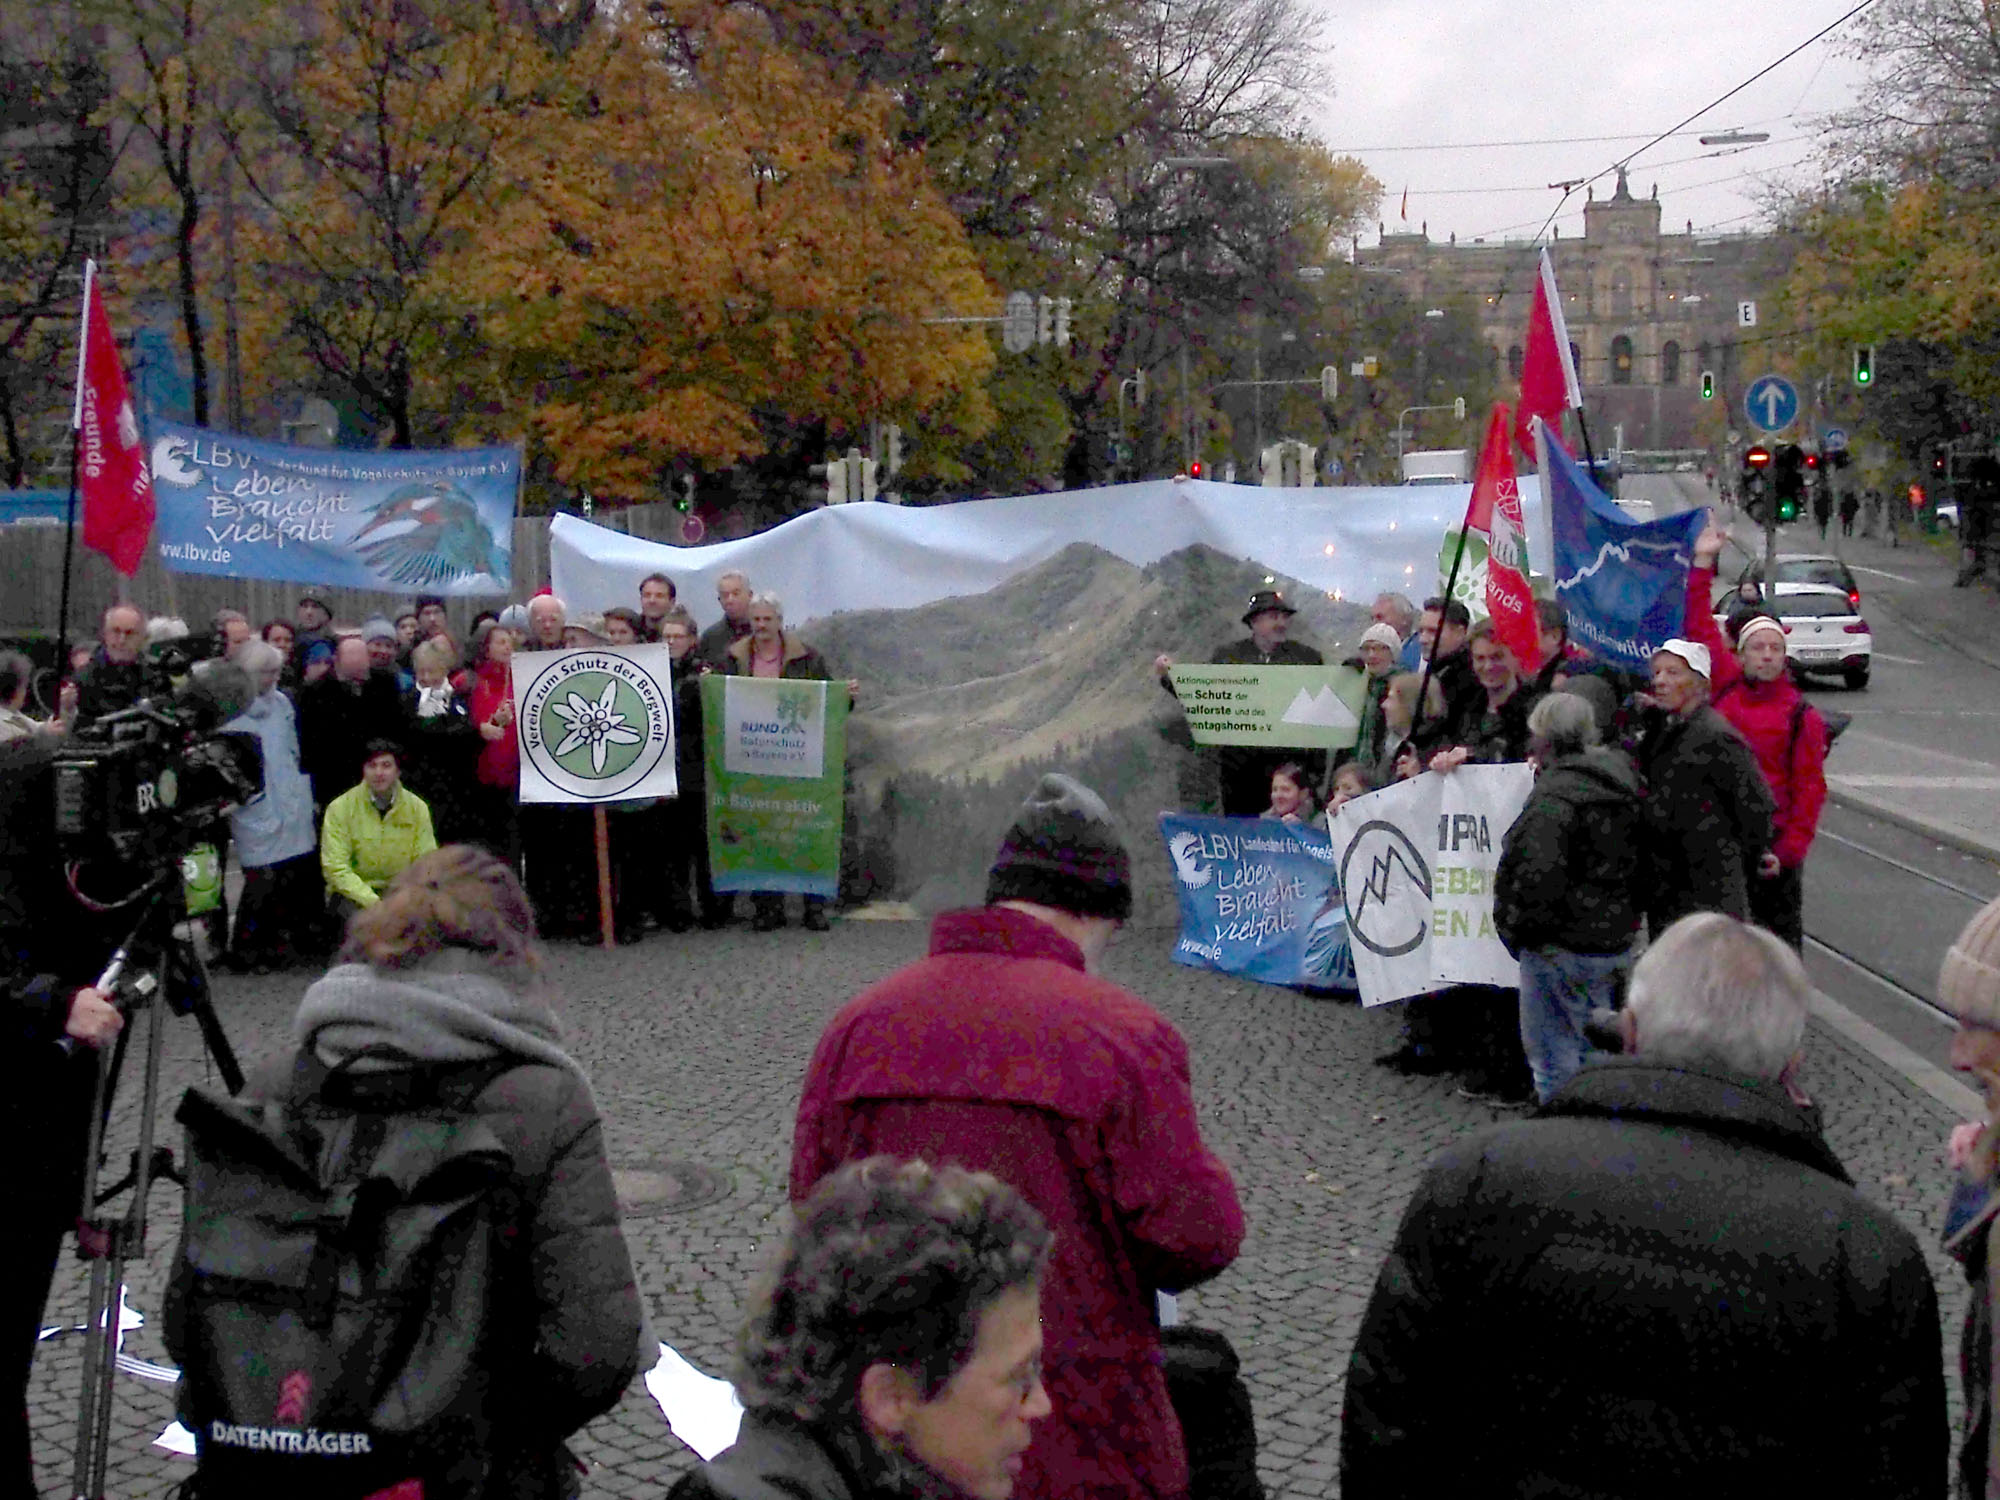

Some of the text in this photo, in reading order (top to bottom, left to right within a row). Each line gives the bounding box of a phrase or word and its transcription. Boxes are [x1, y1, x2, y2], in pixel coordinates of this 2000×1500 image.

[1743, 304, 1751, 321] E
[193, 439, 250, 470] LBV
[212, 469, 315, 497] Leben
[206, 491, 350, 522] Braucht
[205, 516, 336, 549] Vielfalt
[525, 659, 665, 749] Verein zum Schutz der Bergwelt
[1195, 689, 1232, 700] Schutz
[740, 721, 779, 736] BUND
[136, 782, 160, 814] BR
[1199, 834, 1240, 861] LBV
[1438, 814, 1492, 853] IPRA
[1218, 859, 1277, 891] Leben
[1215, 876, 1307, 920] Braucht
[1215, 907, 1297, 947] Vielfalt
[212, 1419, 373, 1455] DATENTRÄGER
